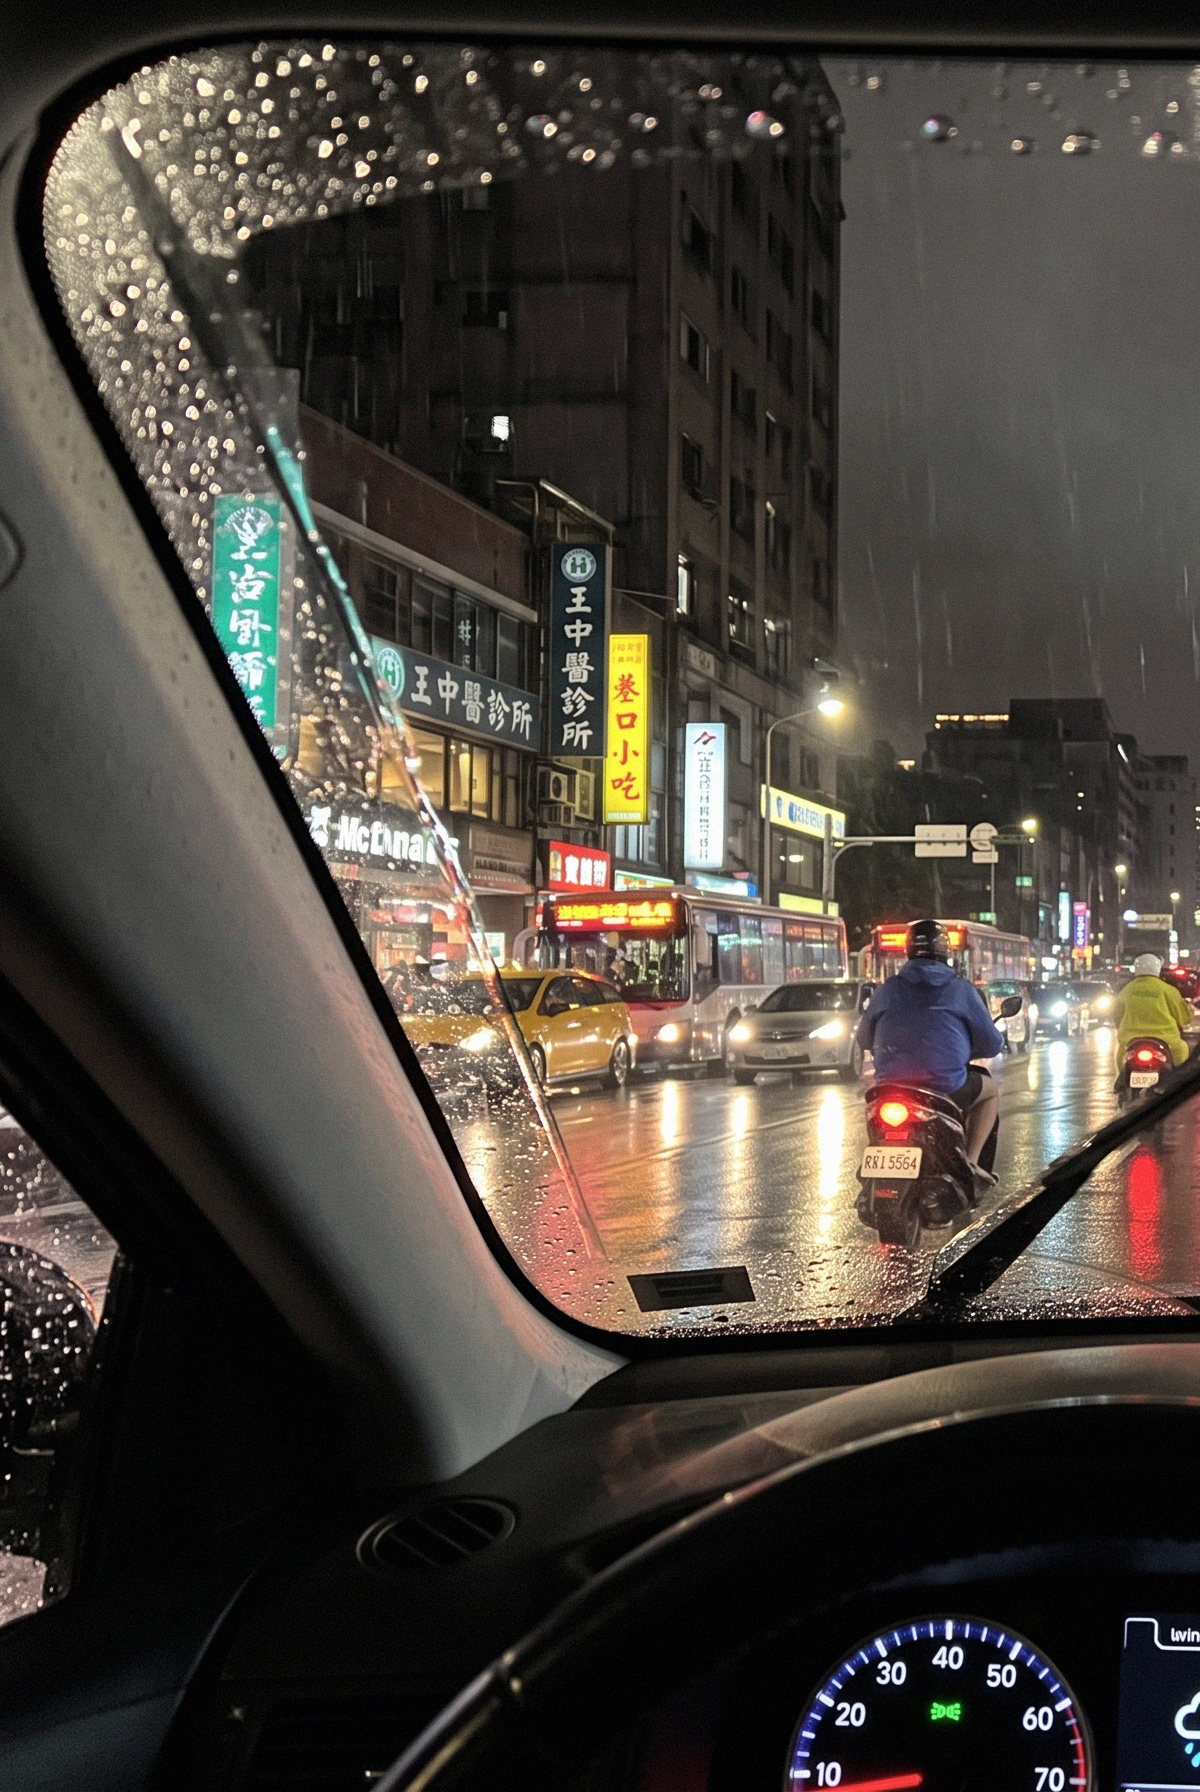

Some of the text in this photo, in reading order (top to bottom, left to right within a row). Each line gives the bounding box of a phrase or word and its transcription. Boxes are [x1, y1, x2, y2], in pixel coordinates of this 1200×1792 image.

[561, 586, 595, 750] 王中醫診所
[411, 665, 532, 741] 王中醫診所
[932, 1646, 964, 1669] 40
[876, 1661, 907, 1685] 30
[986, 1664, 1017, 1688] 50
[834, 1702, 866, 1726] 20
[1022, 1706, 1053, 1731] 60
[815, 1761, 842, 1787] 10
[1034, 1767, 1065, 1792] 70
